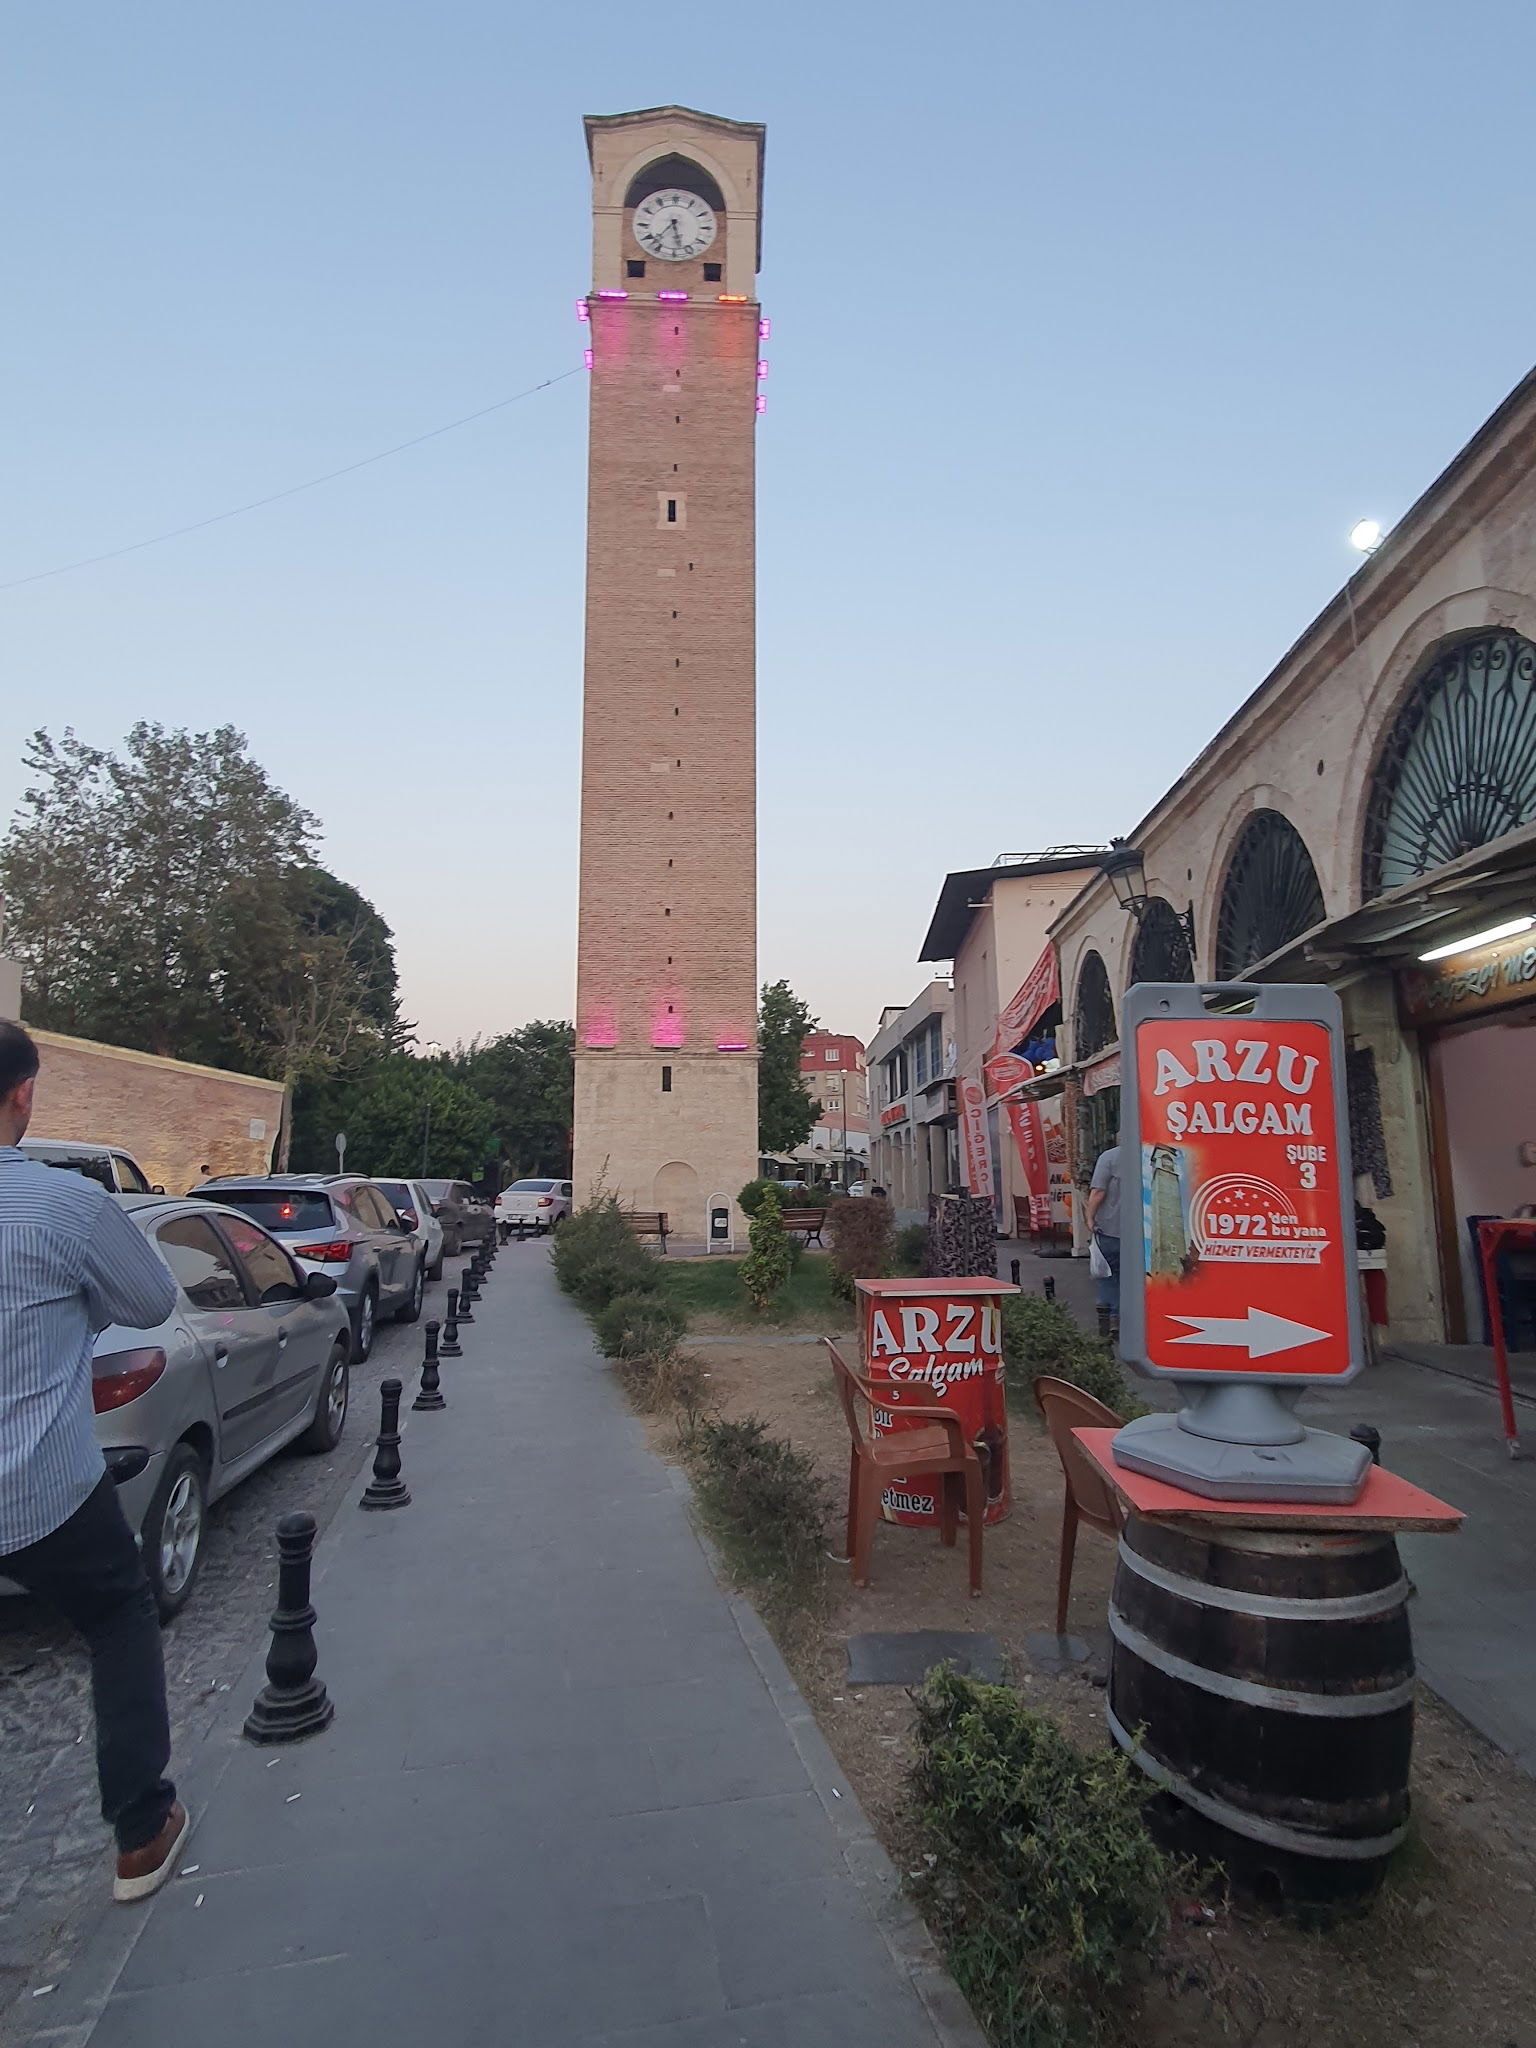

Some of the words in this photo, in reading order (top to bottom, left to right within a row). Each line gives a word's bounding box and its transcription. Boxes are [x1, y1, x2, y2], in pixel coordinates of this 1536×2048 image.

[1153, 1040, 1319, 1095] ARZU
[1166, 1101, 1313, 1141] ŞALGAM
[1285, 1143, 1328, 1165] ŞUBE
[1300, 1162, 1317, 1189] 3
[1207, 1213, 1267, 1236] 1972
[1271, 1224, 1290, 1236] bu
[1292, 1226, 1327, 1239] yana
[1204, 1240, 1244, 1257] HİZMET
[872, 1303, 1002, 1357] ARZU
[881, 1487, 934, 1514] etmez
